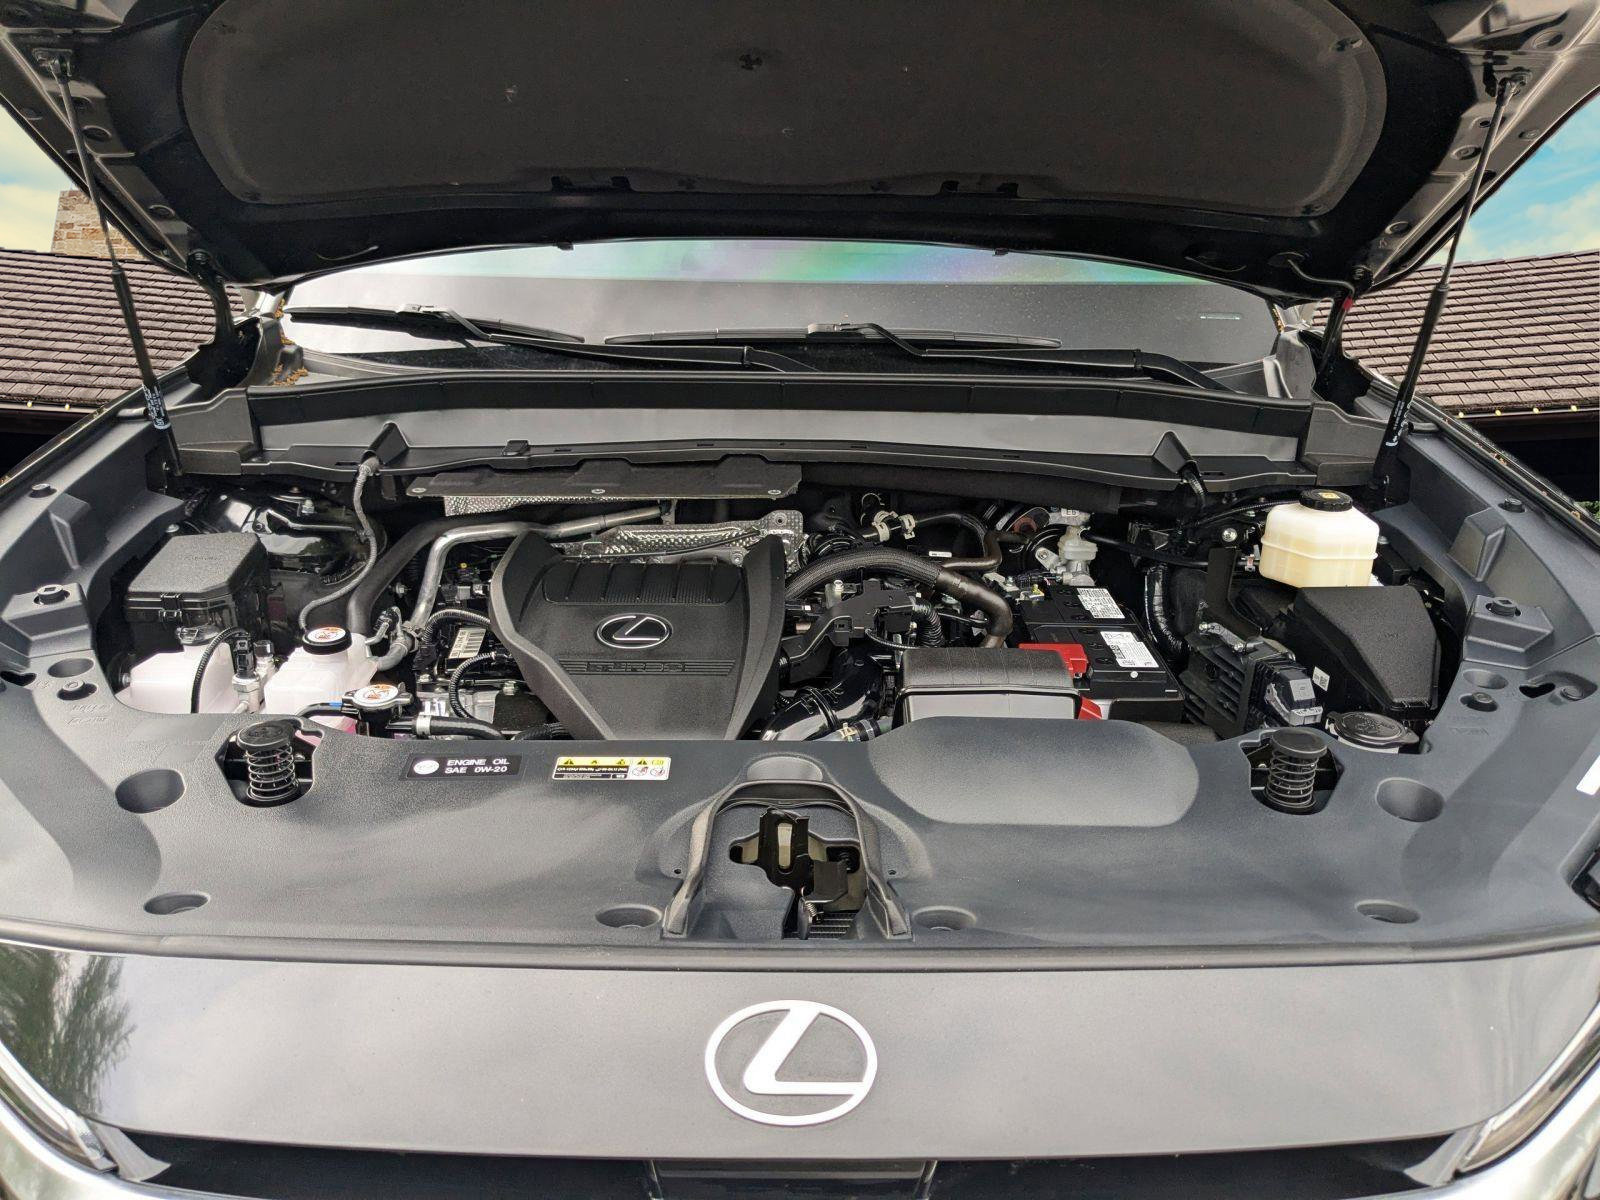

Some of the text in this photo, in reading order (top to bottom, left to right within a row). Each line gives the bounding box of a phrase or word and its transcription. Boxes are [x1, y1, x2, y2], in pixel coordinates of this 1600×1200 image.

[446, 758, 487, 766] ENGINE
[444, 766, 468, 774] SAE
[474, 765, 508, 773] 0W-20
